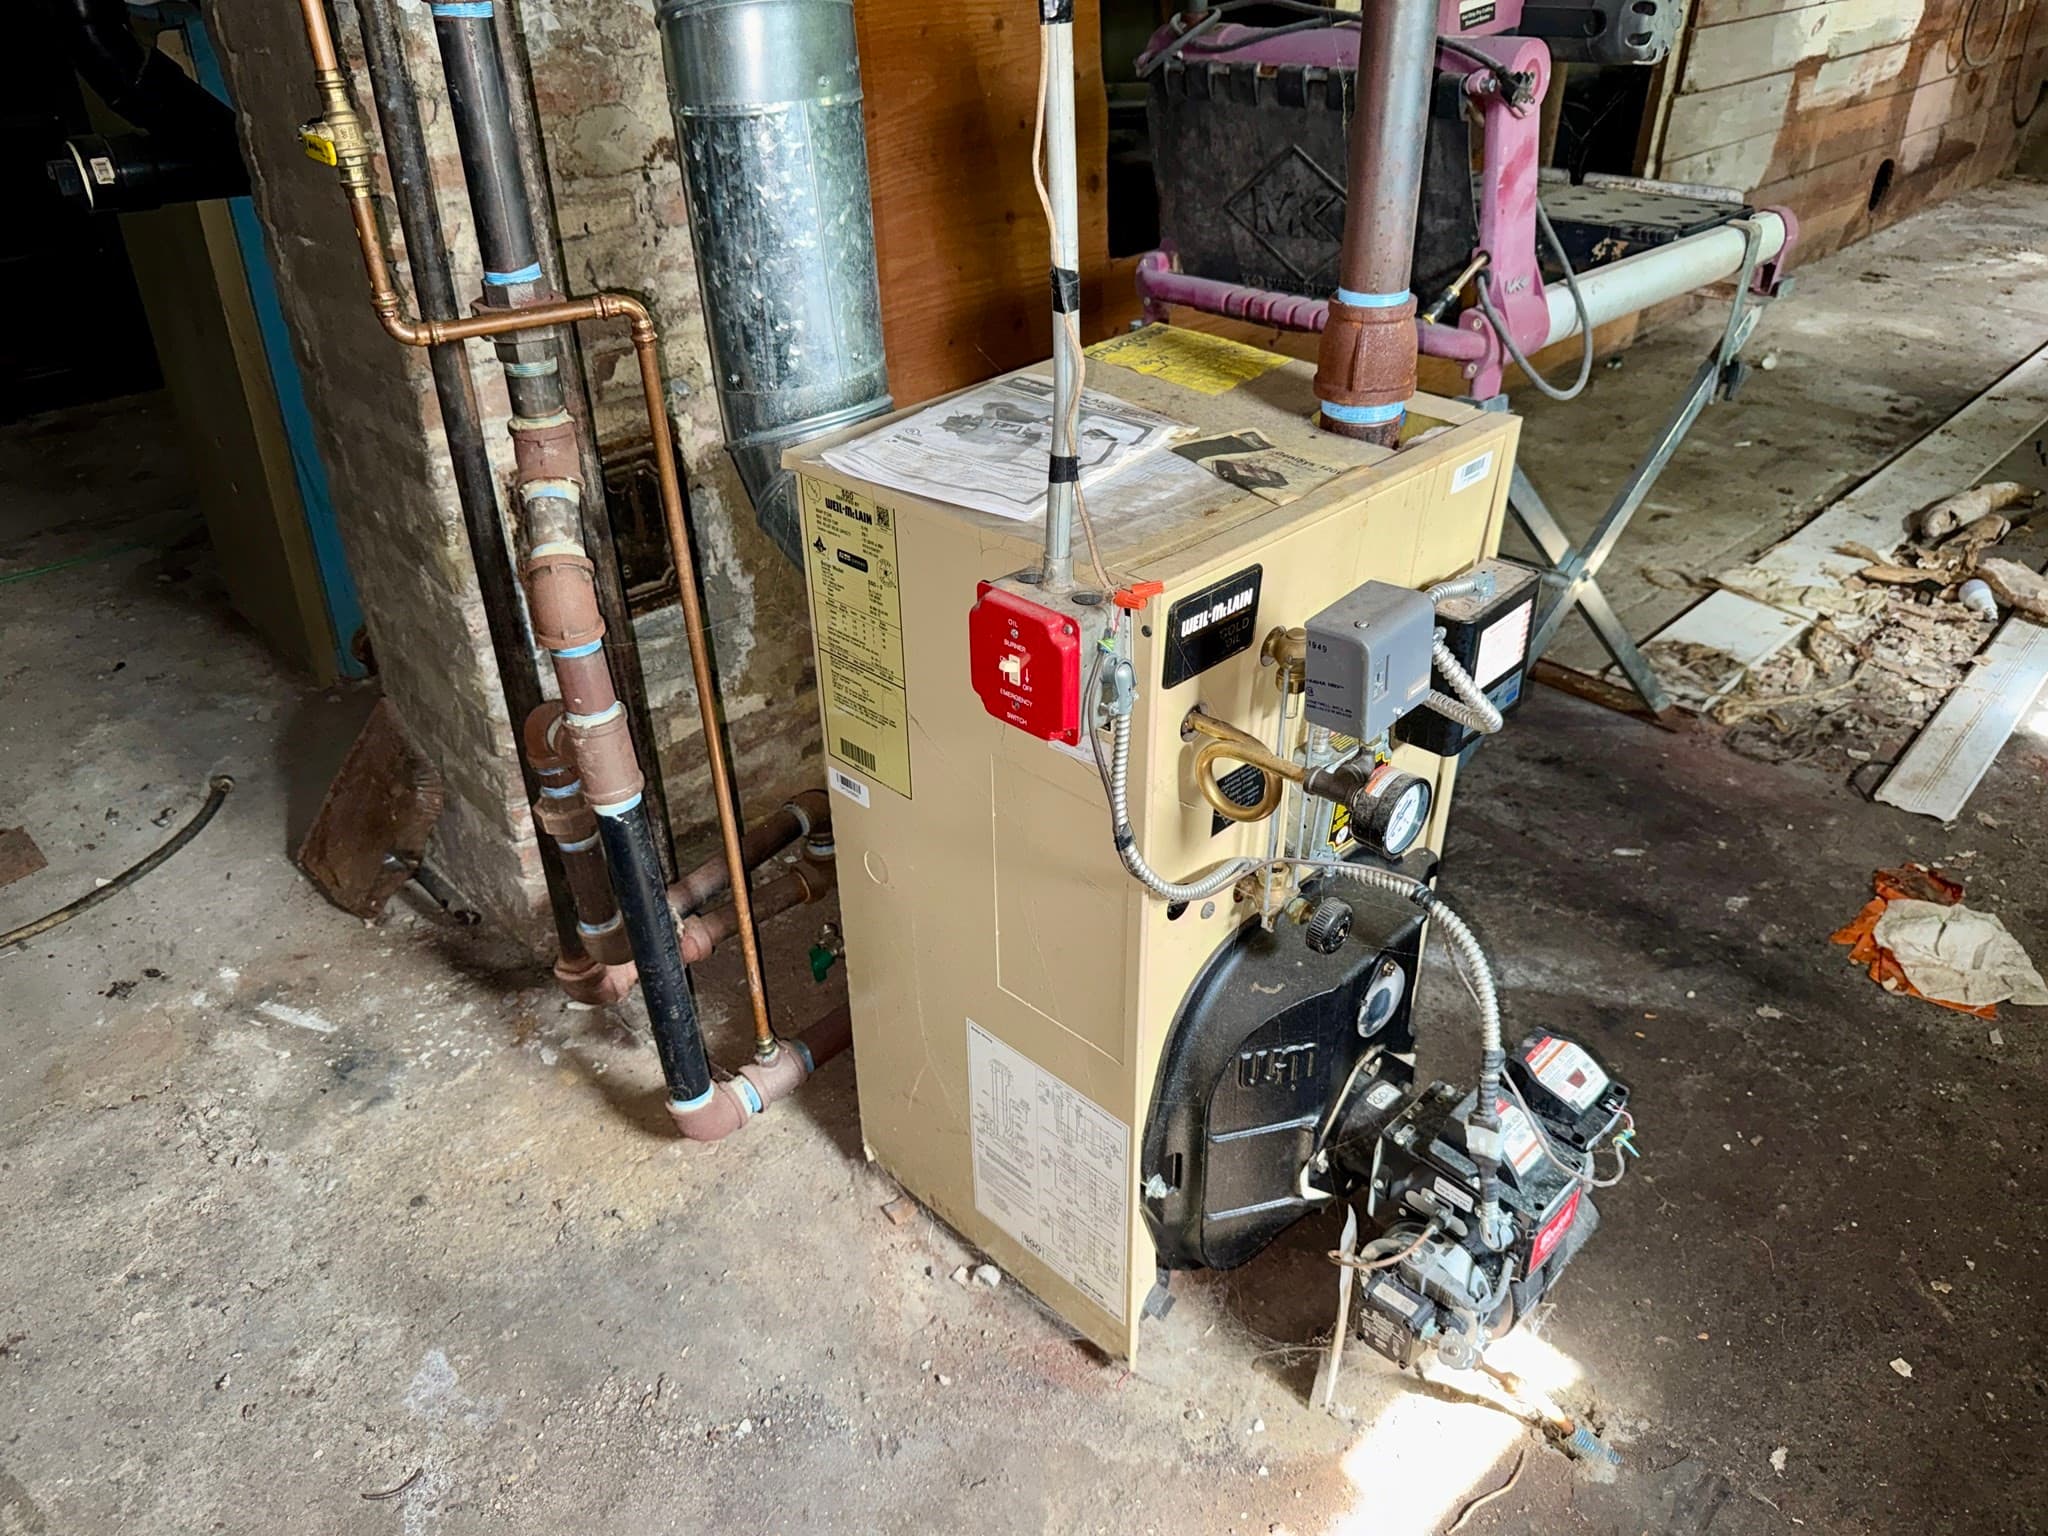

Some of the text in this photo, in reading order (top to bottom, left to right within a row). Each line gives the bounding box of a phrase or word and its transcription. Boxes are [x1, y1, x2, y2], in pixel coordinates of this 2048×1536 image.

[1008, 619, 1018, 628] OIL
[1219, 617, 1250, 640] GOLD
[1003, 639, 1026, 652] BURNER
[1225, 634, 1241, 648] OIL
[1022, 684, 1032, 692] OFF
[1000, 688, 1032, 707] EMERGENCY
[1007, 712, 1027, 725] SWITCH
